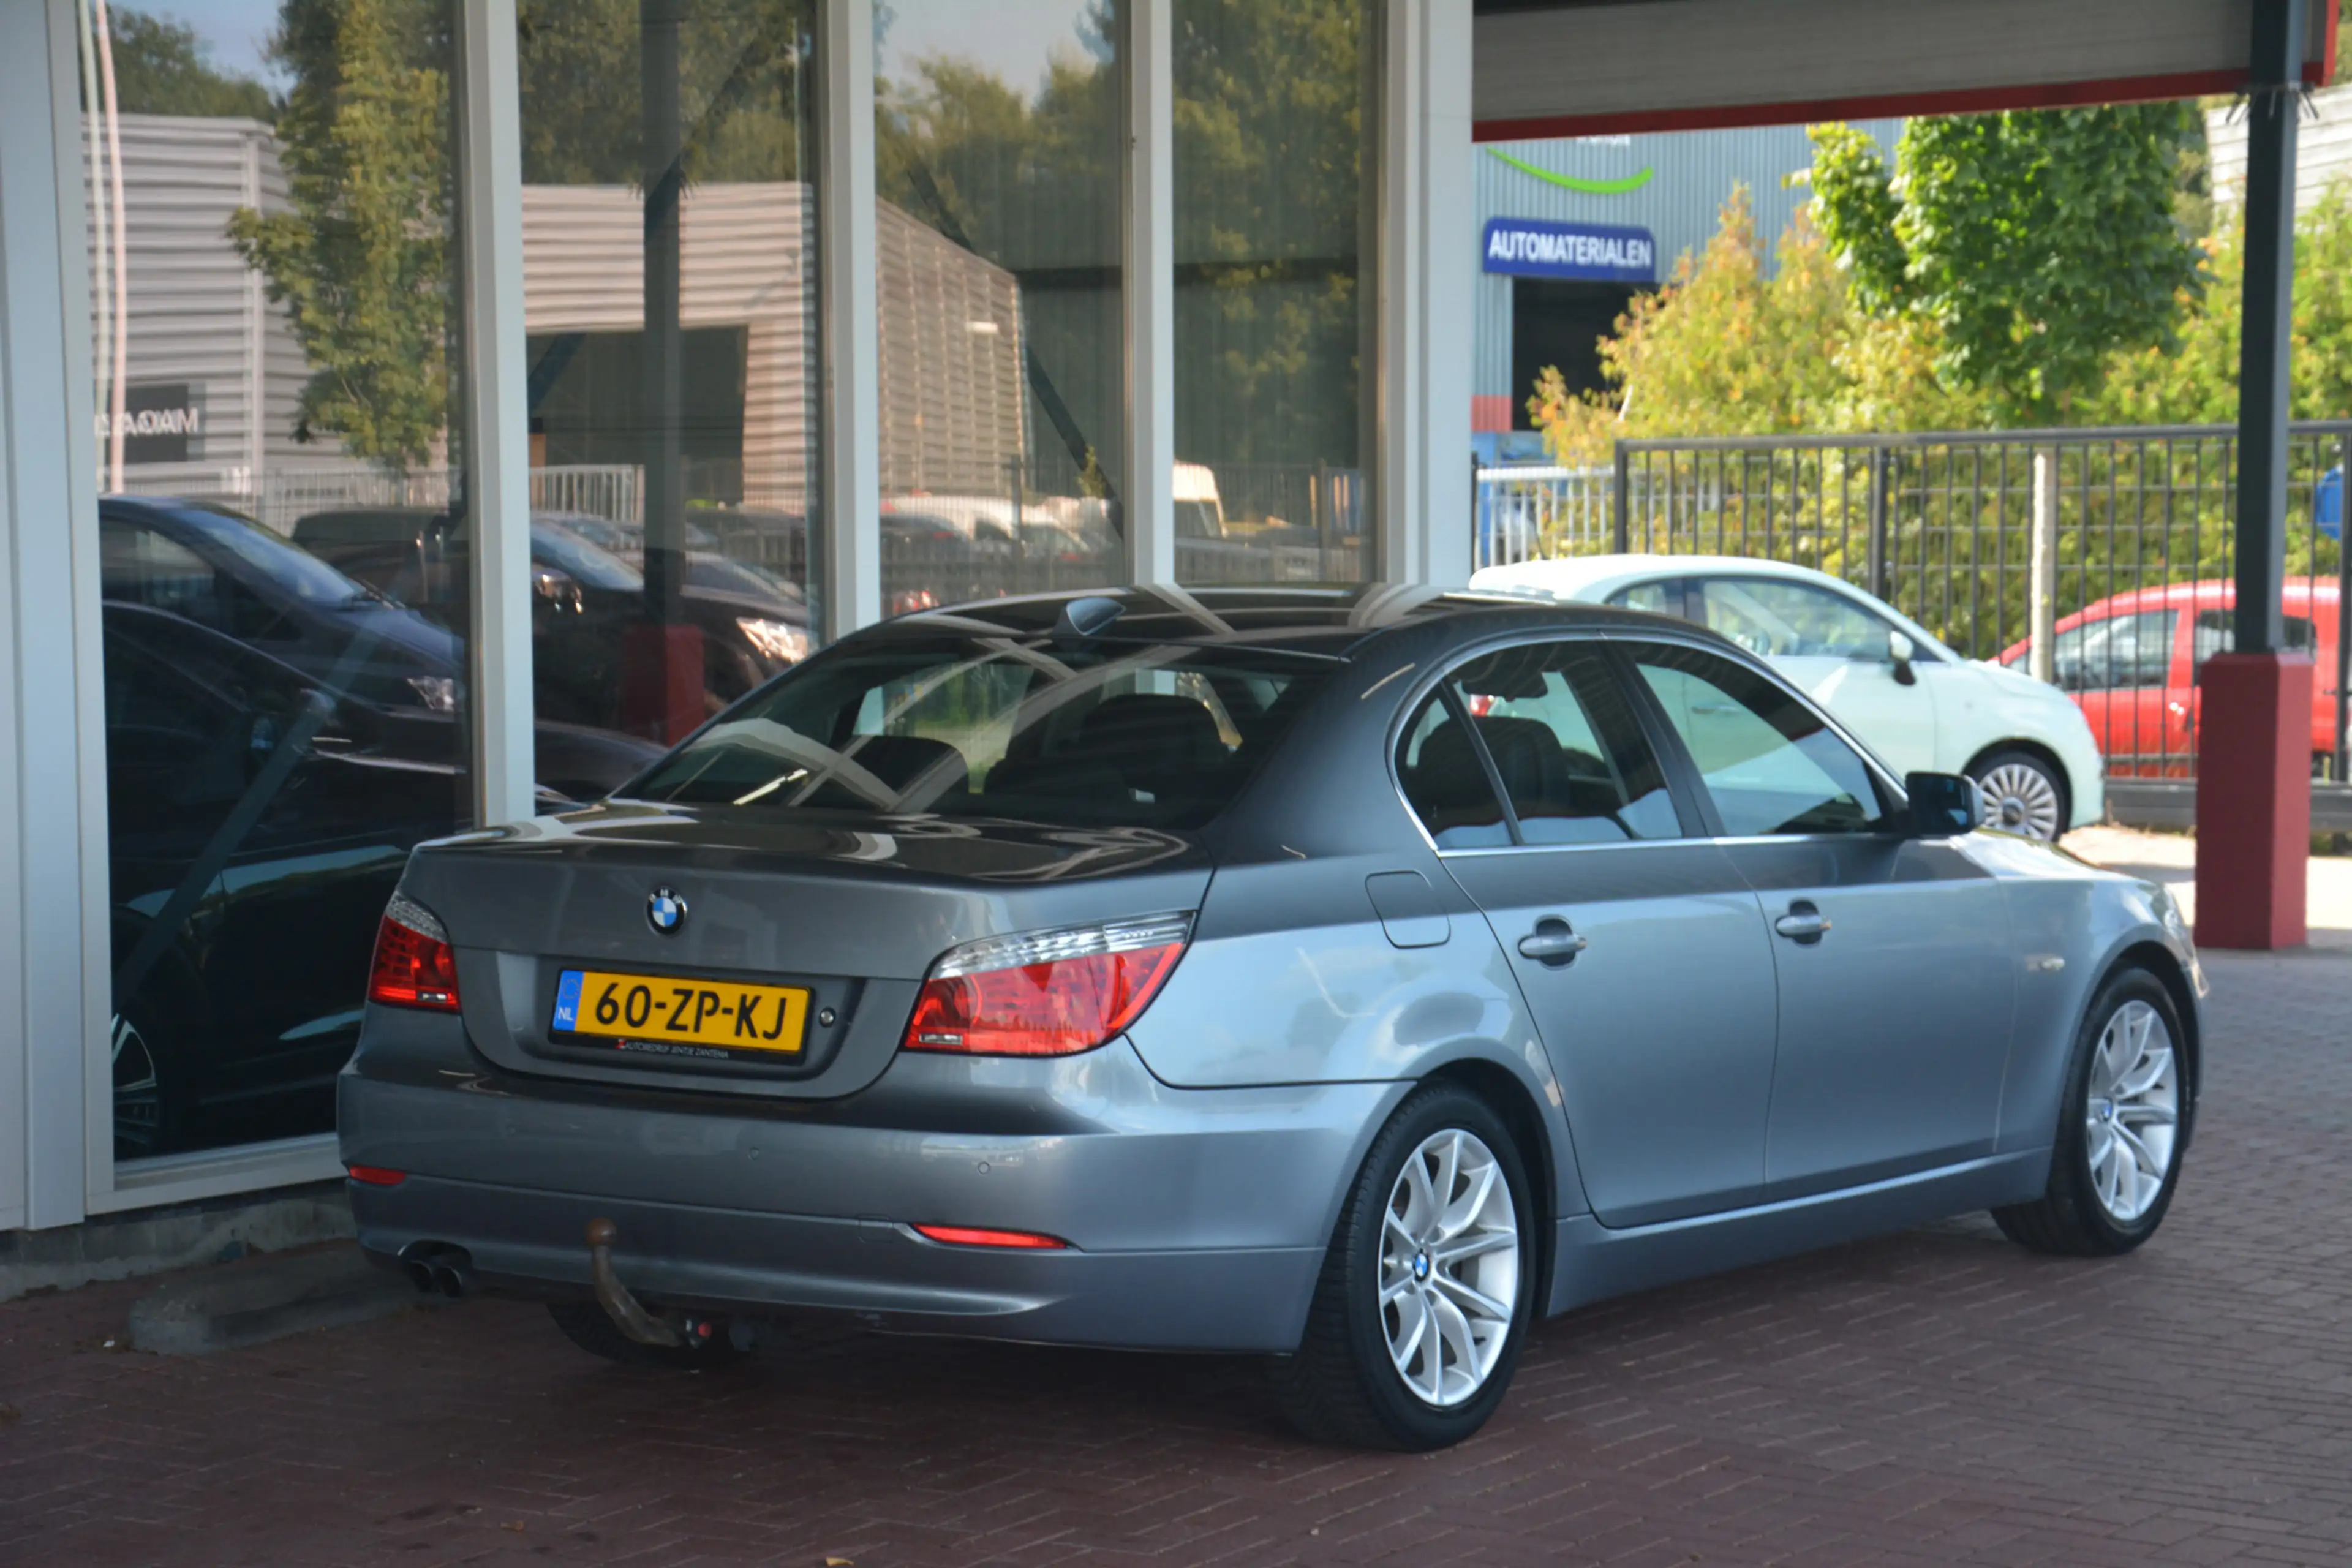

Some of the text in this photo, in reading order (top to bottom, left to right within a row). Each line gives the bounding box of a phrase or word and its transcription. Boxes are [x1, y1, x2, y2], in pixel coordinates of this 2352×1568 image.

[1488, 229, 1651, 268] AUTOMATERIALEN
[557, 1006, 574, 1021] NL
[595, 982, 787, 1040] 60-ZP-KJ
